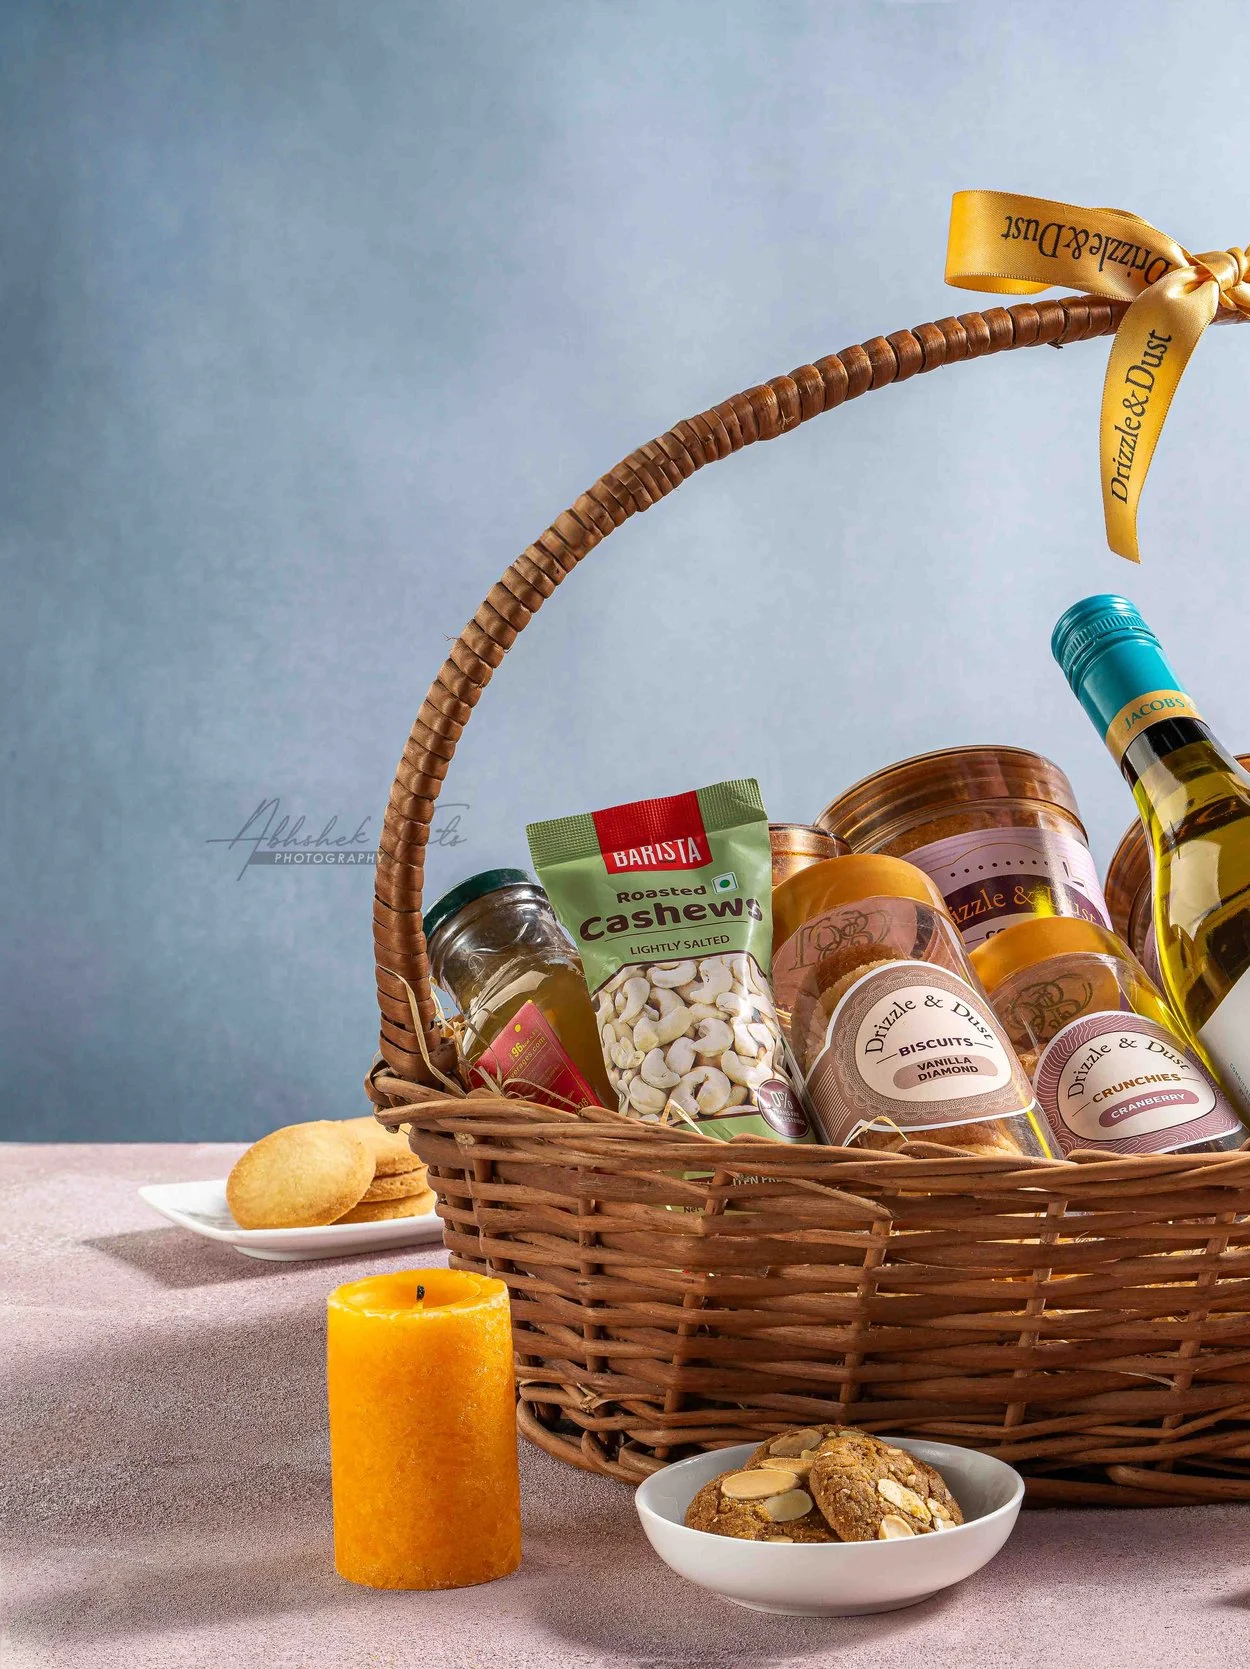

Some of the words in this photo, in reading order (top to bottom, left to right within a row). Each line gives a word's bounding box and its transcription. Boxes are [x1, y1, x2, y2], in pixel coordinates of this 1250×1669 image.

[1110, 329, 1172, 504] Drizzle&Dust
[1124, 697, 1185, 731] JACOB'S
[613, 836, 702, 868] BARISTA
[616, 885, 707, 904] Roasted
[949, 888, 1006, 925] izzle
[579, 897, 763, 942] Cashews
[630, 940, 680, 955] LIGHTLY
[683, 935, 730, 950] SALTED
[865, 1000, 916, 1055] Drizzle
[924, 994, 944, 1008] &
[951, 1001, 994, 1041] Dust
[898, 1037, 974, 1057] BISCUITS
[917, 1056, 972, 1071] VANILLA
[917, 1066, 979, 1082] DIAMOND
[1067, 1044, 1112, 1100] Drizzle
[1118, 1037, 1138, 1049] &
[1145, 1039, 1191, 1071] Dust
[1092, 1073, 1182, 1103] CRUNCHIES
[1110, 1093, 1185, 1119] CRANBERRY
